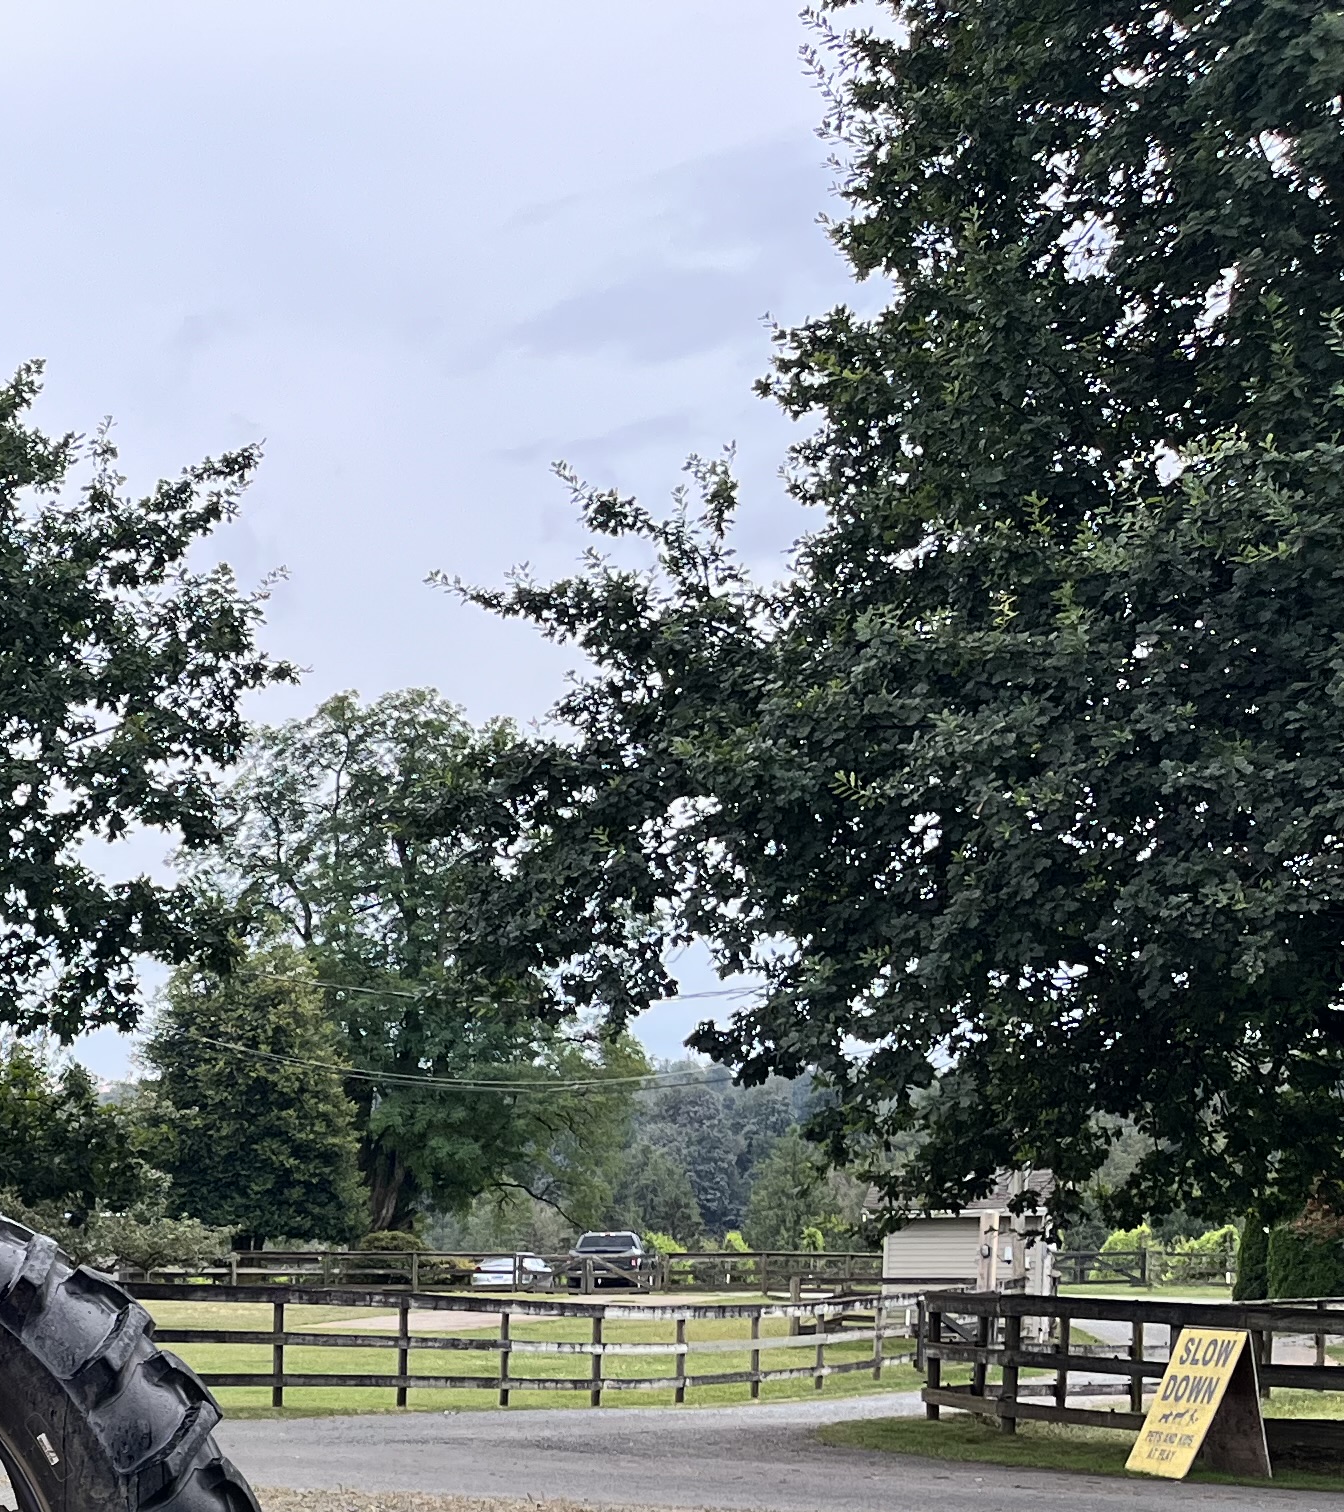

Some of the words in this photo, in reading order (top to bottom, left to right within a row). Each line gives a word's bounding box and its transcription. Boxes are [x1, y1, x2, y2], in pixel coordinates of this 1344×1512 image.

[1179, 1337, 1237, 1368] SLOW
[1161, 1374, 1221, 1405] DOWN
[1163, 1432, 1178, 1445] AND
